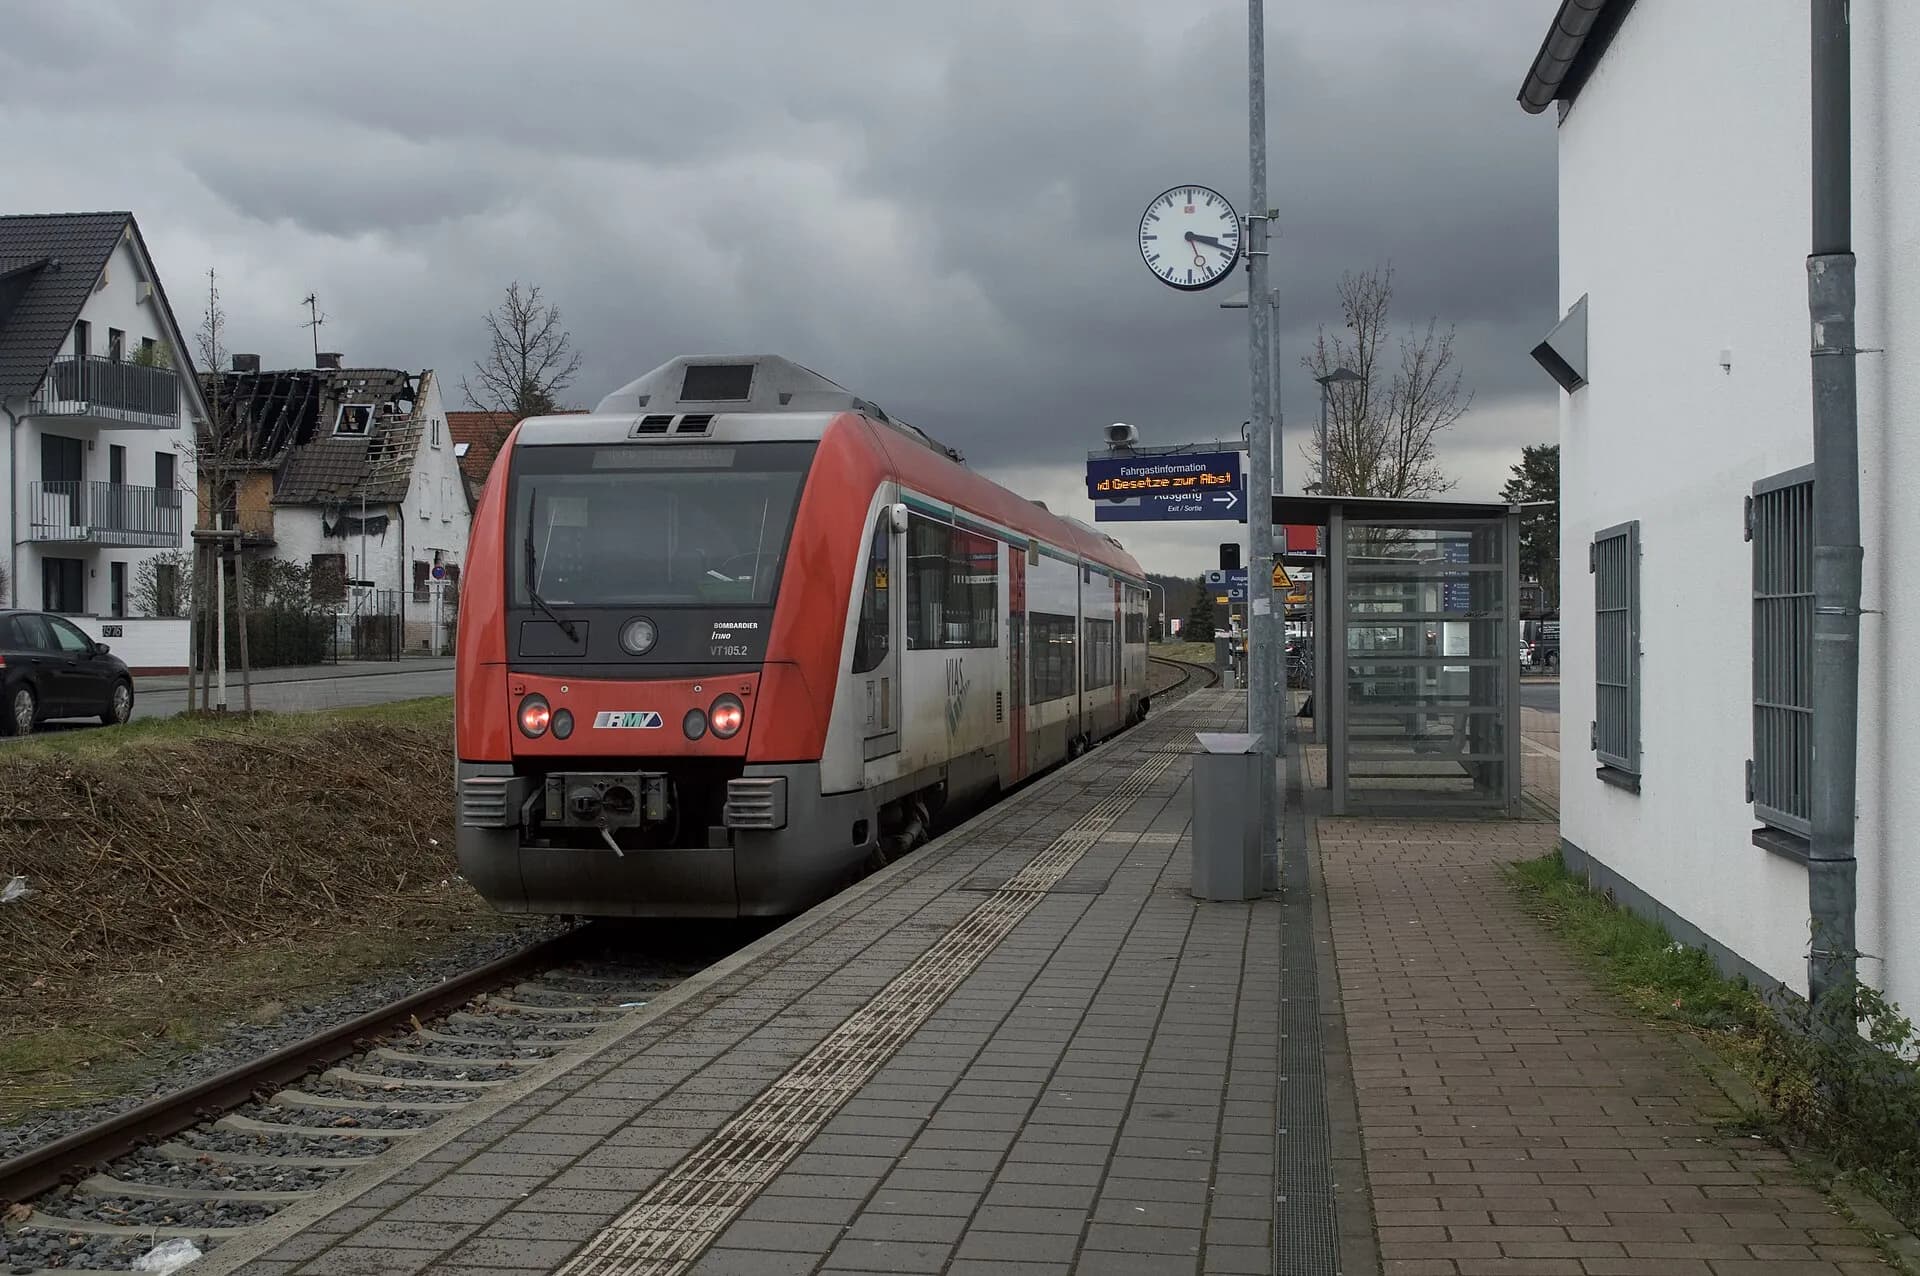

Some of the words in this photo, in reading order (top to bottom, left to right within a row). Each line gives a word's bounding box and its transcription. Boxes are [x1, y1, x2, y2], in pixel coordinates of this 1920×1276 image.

[1120, 463, 1206, 477] Fahrgastinformation
[1112, 477, 1170, 490] Gesetze
[1172, 476, 1197, 487] zur
[1200, 472, 1231, 486] Abst
[606, 712, 658, 728] RMV
